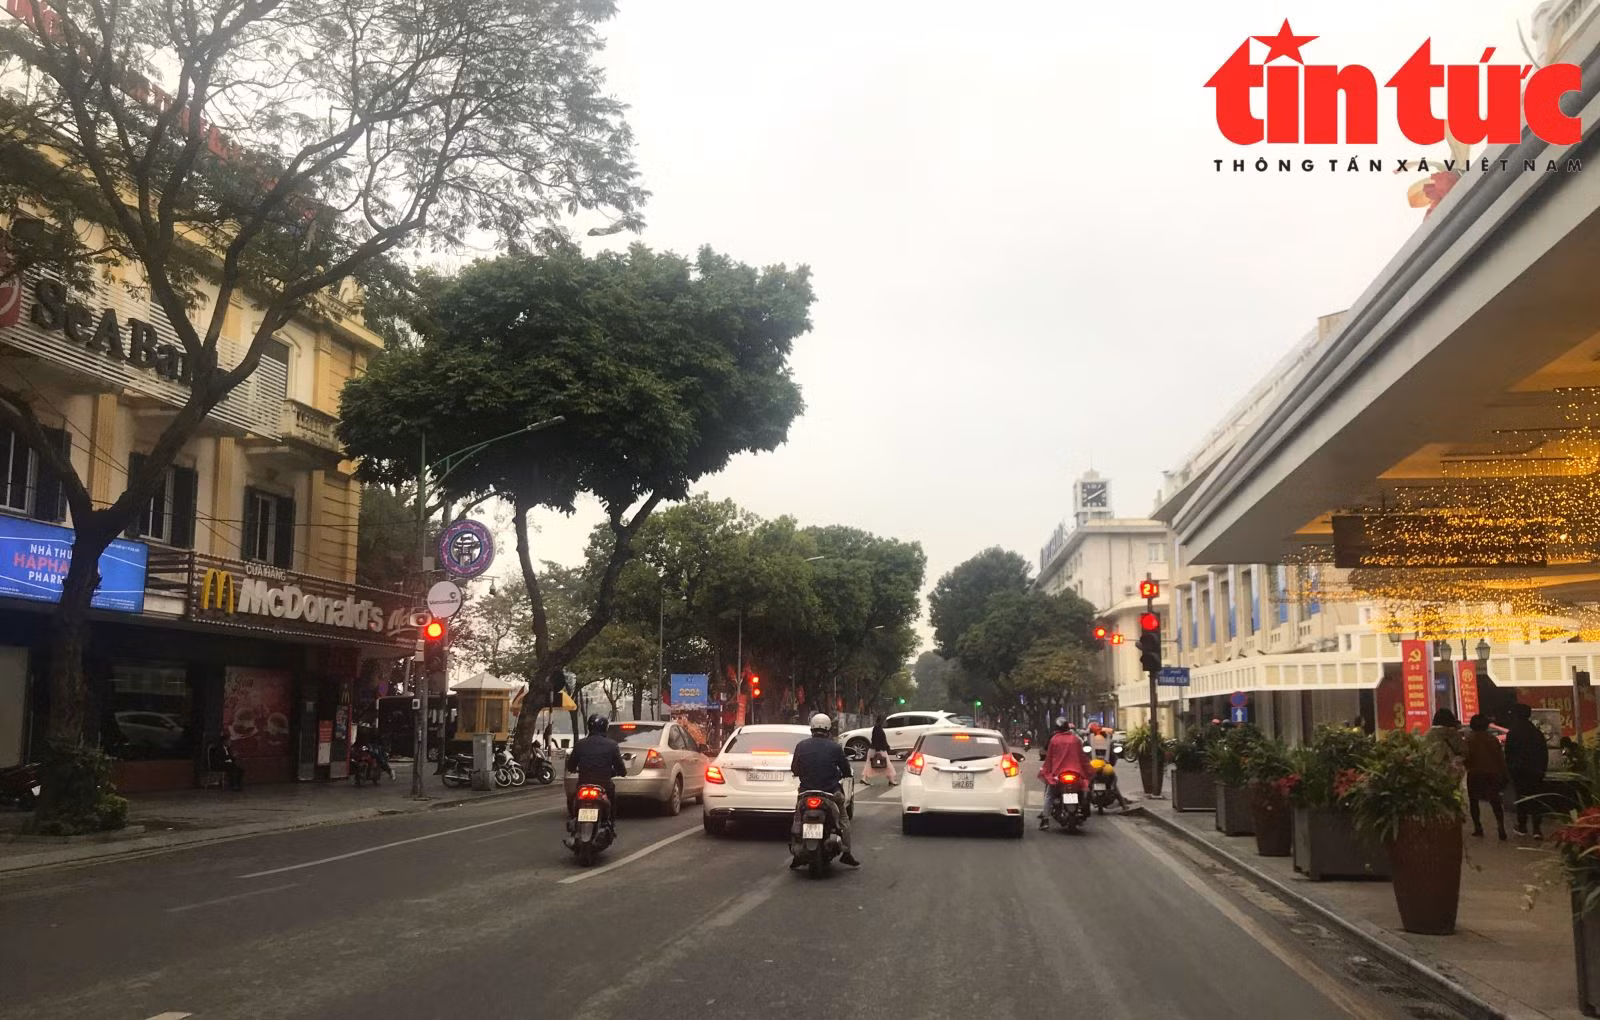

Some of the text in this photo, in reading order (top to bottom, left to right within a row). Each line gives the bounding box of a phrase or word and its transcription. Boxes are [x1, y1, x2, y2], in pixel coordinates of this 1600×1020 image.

[54, 547, 73, 560] THU
[13, 552, 69, 573] HAPHA
[1143, 583, 1157, 595] 21
[237, 578, 384, 633] McDonald's
[1113, 634, 1123, 644] 21
